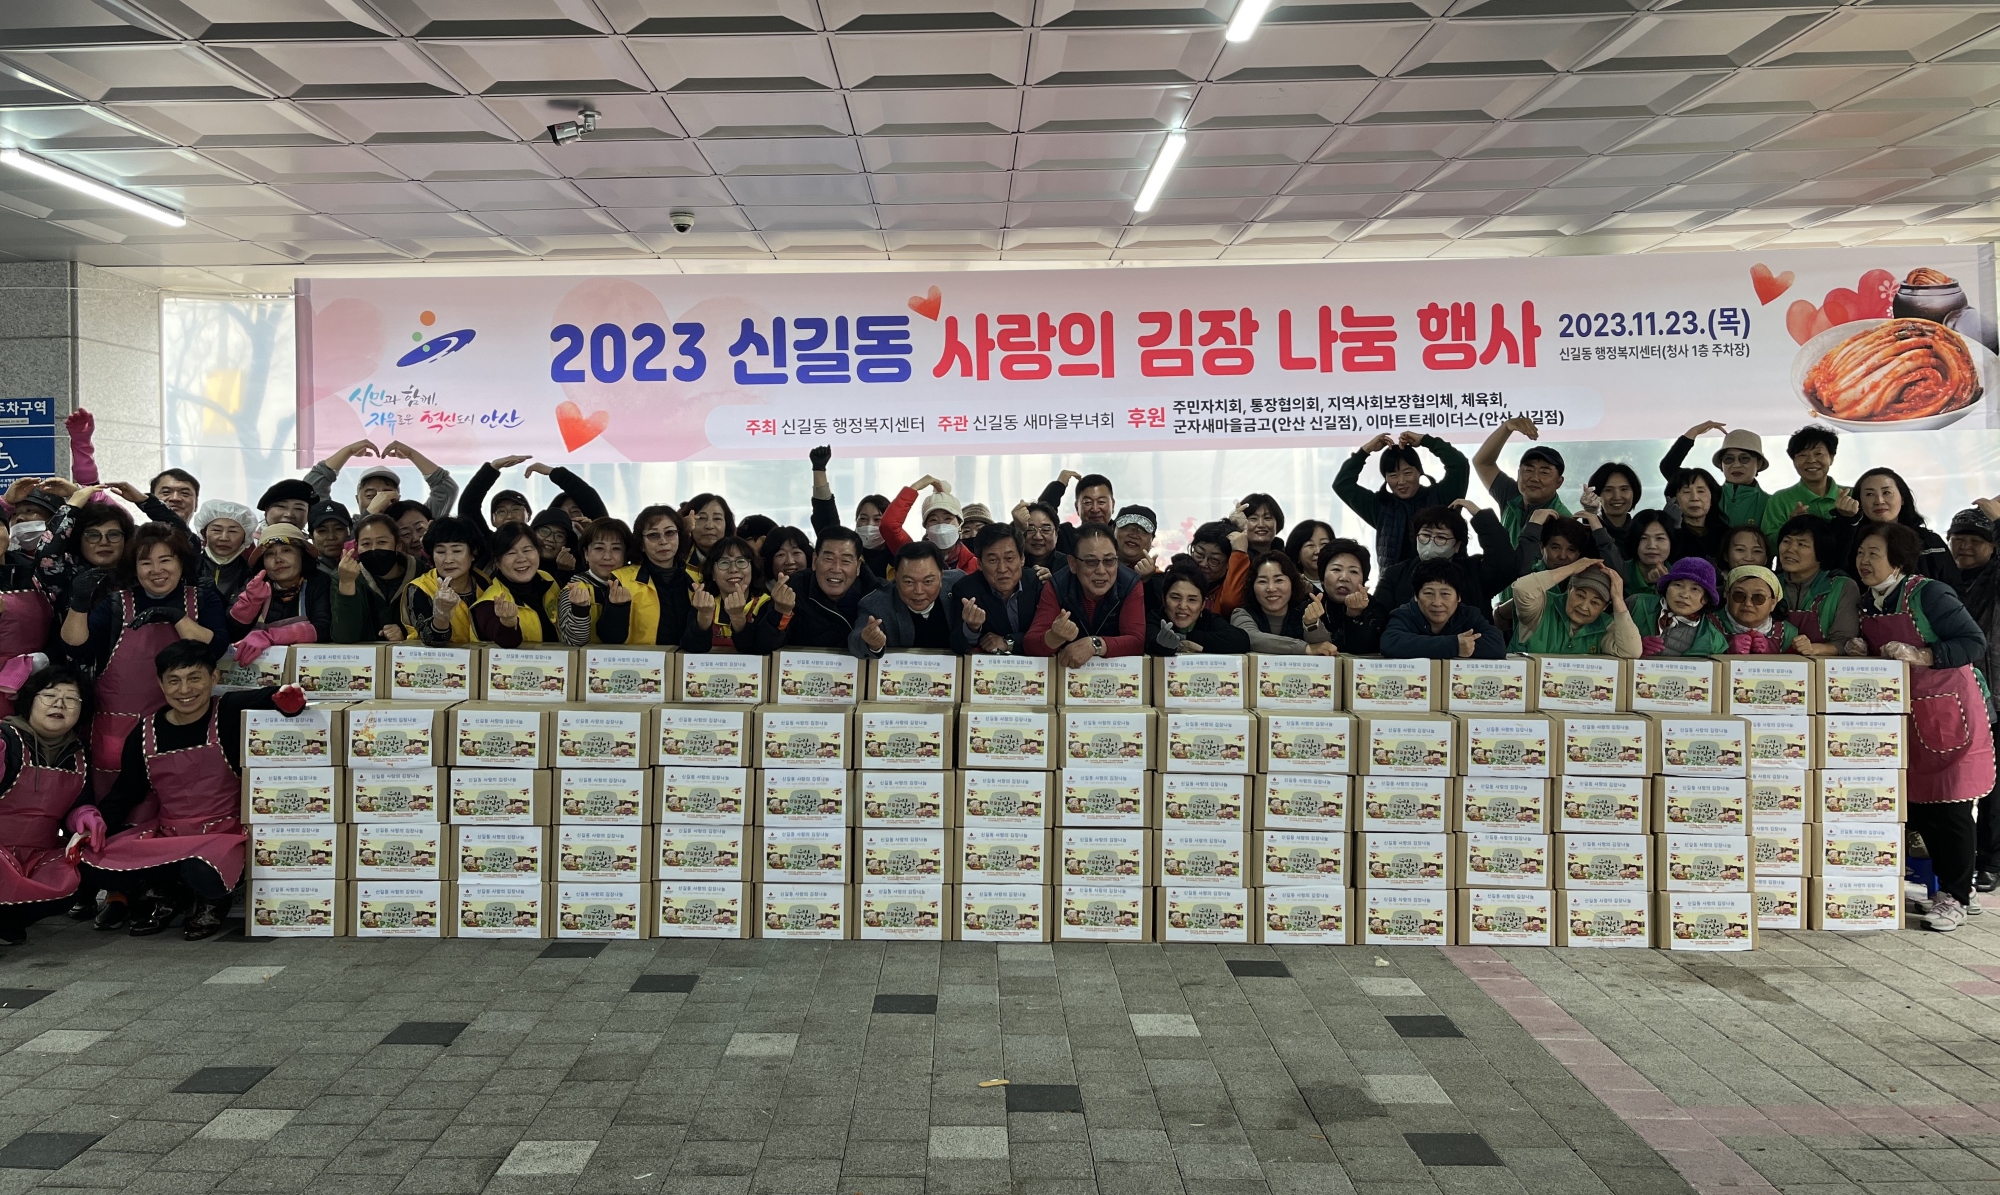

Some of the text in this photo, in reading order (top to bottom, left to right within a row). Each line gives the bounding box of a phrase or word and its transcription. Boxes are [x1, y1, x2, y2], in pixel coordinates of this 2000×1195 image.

[1558, 307, 1751, 340] 2023.11.23.(목)
[550, 300, 1542, 385] 2023 신길동 사랑의 김장 나눔 행사
[1559, 342, 1751, 361] 신길동 행정복지센터(청사 1층 주차장)
[349, 383, 400, 414] 시민과
[1172, 391, 1508, 416] 주민자치회, 통장협의회, 지역사회보장협의체, 체육회,
[365, 409, 526, 436] 자유로운 혁신도시 안산
[745, 416, 925, 436] 주최 신길동 행정복지센터
[937, 411, 1115, 432] 주관 신길동 새마을부녀회
[1127, 406, 1166, 429] 후원
[1172, 416, 1306, 435] 군자새마을금고(안산
[1309, 414, 1363, 433] 신길점),
